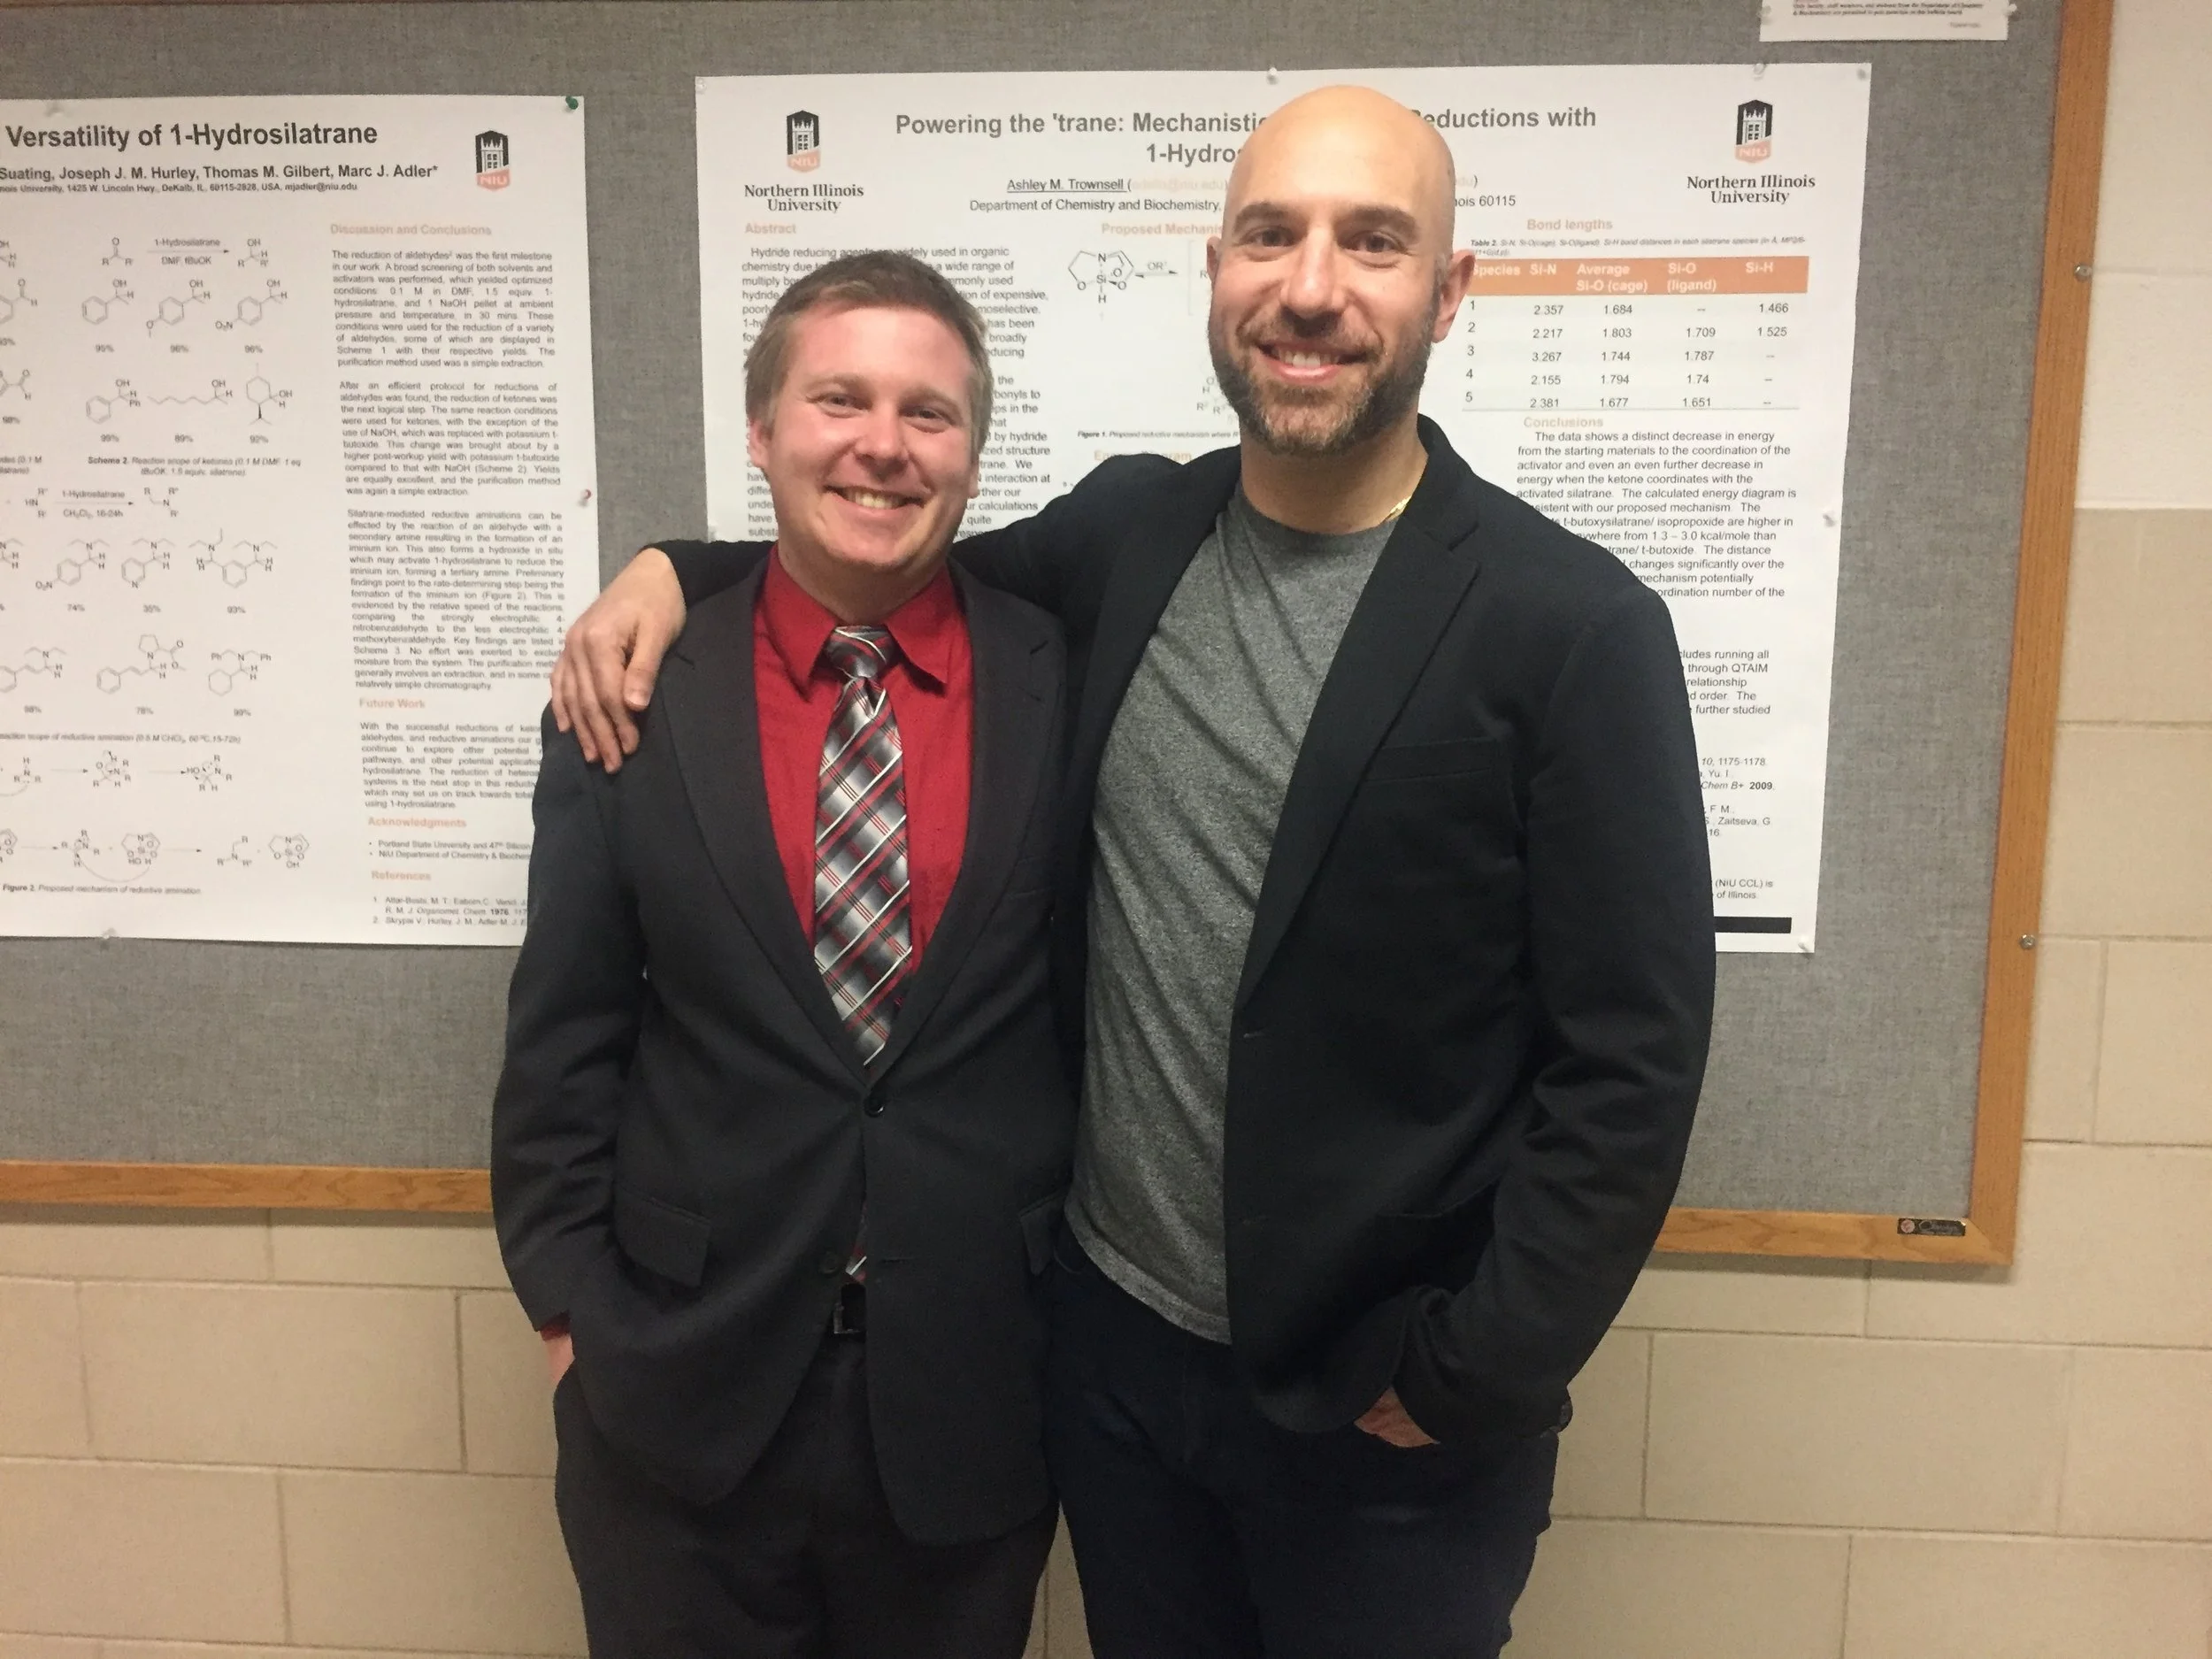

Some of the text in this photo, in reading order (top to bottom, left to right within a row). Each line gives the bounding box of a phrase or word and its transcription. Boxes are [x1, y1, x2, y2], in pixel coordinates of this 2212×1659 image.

[1411, 106, 1595, 128] eductions with
[896, 112, 1001, 139] Powering
[1010, 112, 1044, 133] the
[1053, 111, 1123, 132] 'trane:
[4, 120, 377, 153] Versatility of 1-Hydrosilatrane
[58, 166, 110, 182] Joseph
[114, 166, 126, 179] J.
[131, 166, 146, 179] M.
[150, 165, 198, 181] Hurley,
[203, 165, 258, 178] Thomas
[263, 165, 278, 177] M.
[283, 165, 333, 179] Gilbert,
[338, 164, 372, 177] Marc
[377, 165, 388, 176] J.
[1007, 179, 1046, 192] Ashley
[1050, 179, 1064, 190] M.
[1069, 179, 1124, 191] Trownsell
[1687, 174, 1815, 191] Northern Illinois
[744, 183, 864, 199] Northern Illinois
[1711, 189, 1789, 204] University
[767, 196, 841, 213] University
[970, 199, 1037, 212] Department
[1041, 199, 1052, 211] of
[1055, 198, 1115, 212] Chemistry
[1118, 199, 1140, 210] and
[1479, 195, 1516, 207] 60115
[329, 221, 491, 235] Discussion and Conclusions
[745, 223, 796, 234] Abstract
[1102, 223, 1160, 236] Proposed
[1527, 219, 1612, 232] Bond lengths
[750, 248, 790, 259] Hydride
[793, 248, 837, 260] reducing
[931, 247, 956, 257] used
[971, 247, 1009, 258] organic
[1529, 263, 1555, 275] Si-N
[1576, 263, 1630, 277] Average
[1668, 262, 1696, 274] Si-O
[1745, 261, 1773, 273] Si-H
[1576, 279, 1647, 293] Si-O (cage)
[1667, 279, 1717, 293] (ligand)
[1471, 300, 1788, 315] 1 2.357 1.684 1.466
[1467, 321, 1786, 338] 2 2.217 1.803 1.709 1.525
[1467, 344, 1714, 361] 3 3.267 1.744 1.787
[1466, 368, 1709, 384] 4 2.155 1.794 1.74
[1465, 391, 1713, 409] 5 2.381 1.677 1.651
[1524, 416, 1603, 427] Conclusions
[1535, 431, 1774, 442] The data shows distinct decrease energy
[1005, 446, 1049, 455] structure
[1517, 461, 1562, 470] activator
[1565, 460, 1585, 470] and
[1663, 459, 1698, 469] further
[1701, 459, 1750, 469] decrease
[985, 473, 1037, 482] interaction
[1517, 488, 1563, 498] activated
[1622, 488, 1641, 497] The
[1645, 488, 1699, 497] calculated
[1701, 490, 1739, 500] energy
[1741, 488, 1784, 500] diagram
[979, 501, 1038, 511] calculations
[1657, 517, 1724, 527] isopropoxide
[1747, 517, 1781, 528] higher
[1624, 531, 1647, 540] from
[1681, 531, 1697, 541] 3.0
[1701, 531, 1750, 541] kcal/mole
[1754, 531, 1776, 540] than
[1629, 559, 1674, 571] changes
[1678, 559, 1738, 571] significantly
[1768, 559, 1784, 568] the
[1700, 573, 1754, 585] potentially
[1715, 649, 1769, 661] running all
[1688, 663, 1767, 674] through QTAIM
[1686, 677, 1747, 688] relationship
[1737, 690, 1756, 700] The
[359, 697, 425, 708] Future Work
[1695, 704, 1770, 714] further studied
[368, 816, 466, 829] Acknowledgments
[371, 870, 431, 880] References
[1715, 879, 1763, 888] (NIU CCL)
